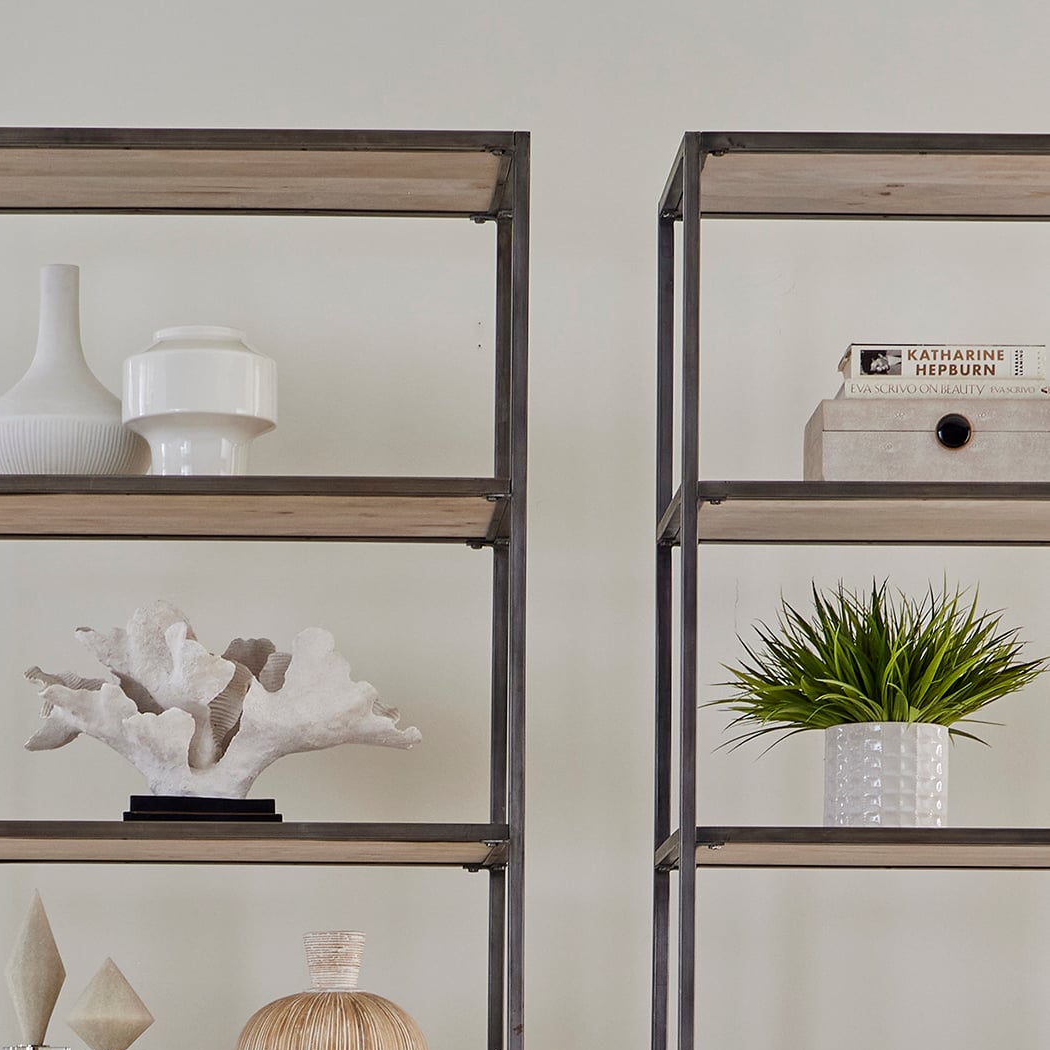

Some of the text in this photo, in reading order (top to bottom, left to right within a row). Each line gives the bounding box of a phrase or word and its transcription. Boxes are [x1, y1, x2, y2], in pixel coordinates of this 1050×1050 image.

[908, 349, 1005, 361] KATHARINE
[916, 364, 996, 376] HEPBURN
[851, 384, 986, 395] EVA SCRIVO ON BEAUTY
